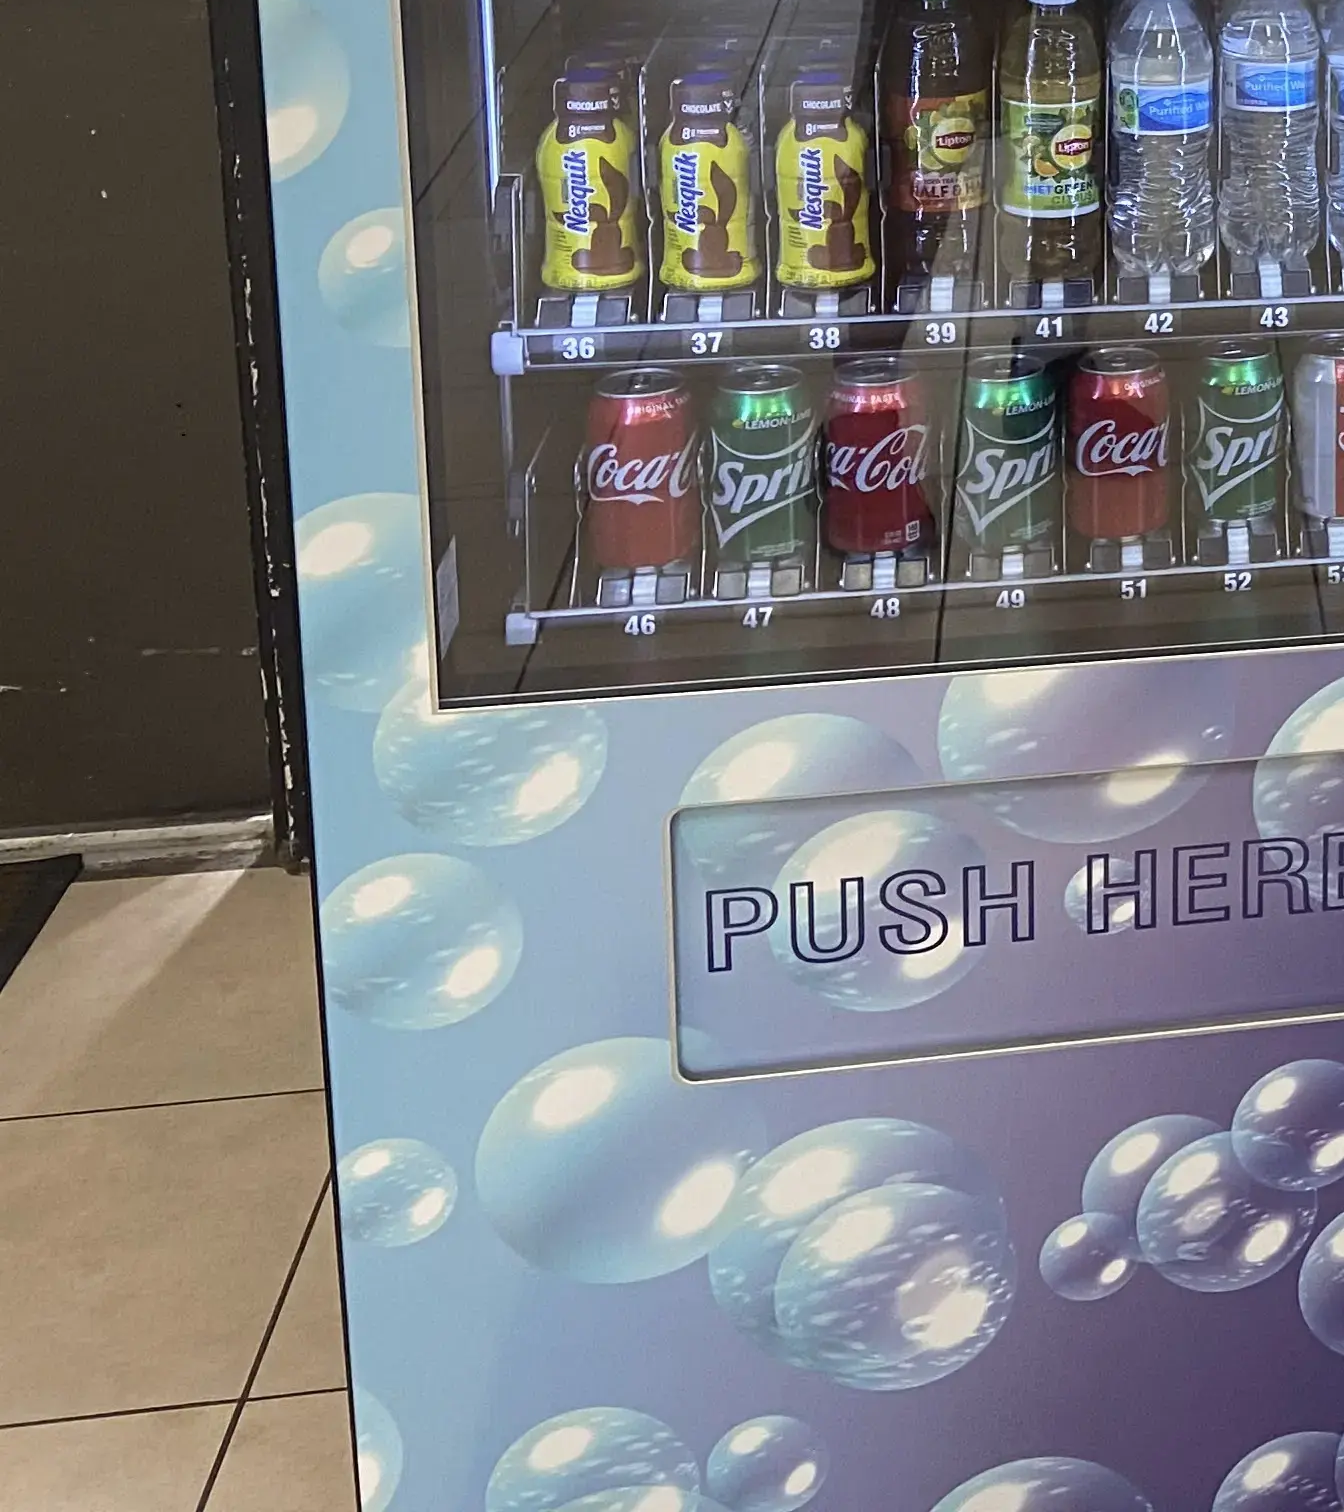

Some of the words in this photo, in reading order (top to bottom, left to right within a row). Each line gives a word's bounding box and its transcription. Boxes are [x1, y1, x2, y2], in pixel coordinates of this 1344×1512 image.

[681, 103, 722, 113] CHOCOLATE
[803, 100, 841, 109] CHOCOLATE
[563, 151, 594, 233] Nesquik
[674, 153, 704, 233] Nesquik
[800, 148, 829, 230] Nesquik
[1035, 317, 1063, 339] 41
[1144, 312, 1174, 334] 42
[1260, 307, 1289, 328] 43
[691, 332, 723, 354] 37
[809, 327, 840, 349] 38
[925, 322, 956, 345] 39
[562, 337, 595, 359] 36
[1120, 580, 1147, 599] 51
[1224, 572, 1252, 592] 52
[870, 597, 900, 619] 48
[996, 589, 1025, 609] 49
[624, 614, 656, 635] 46
[742, 607, 773, 628] 47
[704, 858, 1037, 974] PUSH
